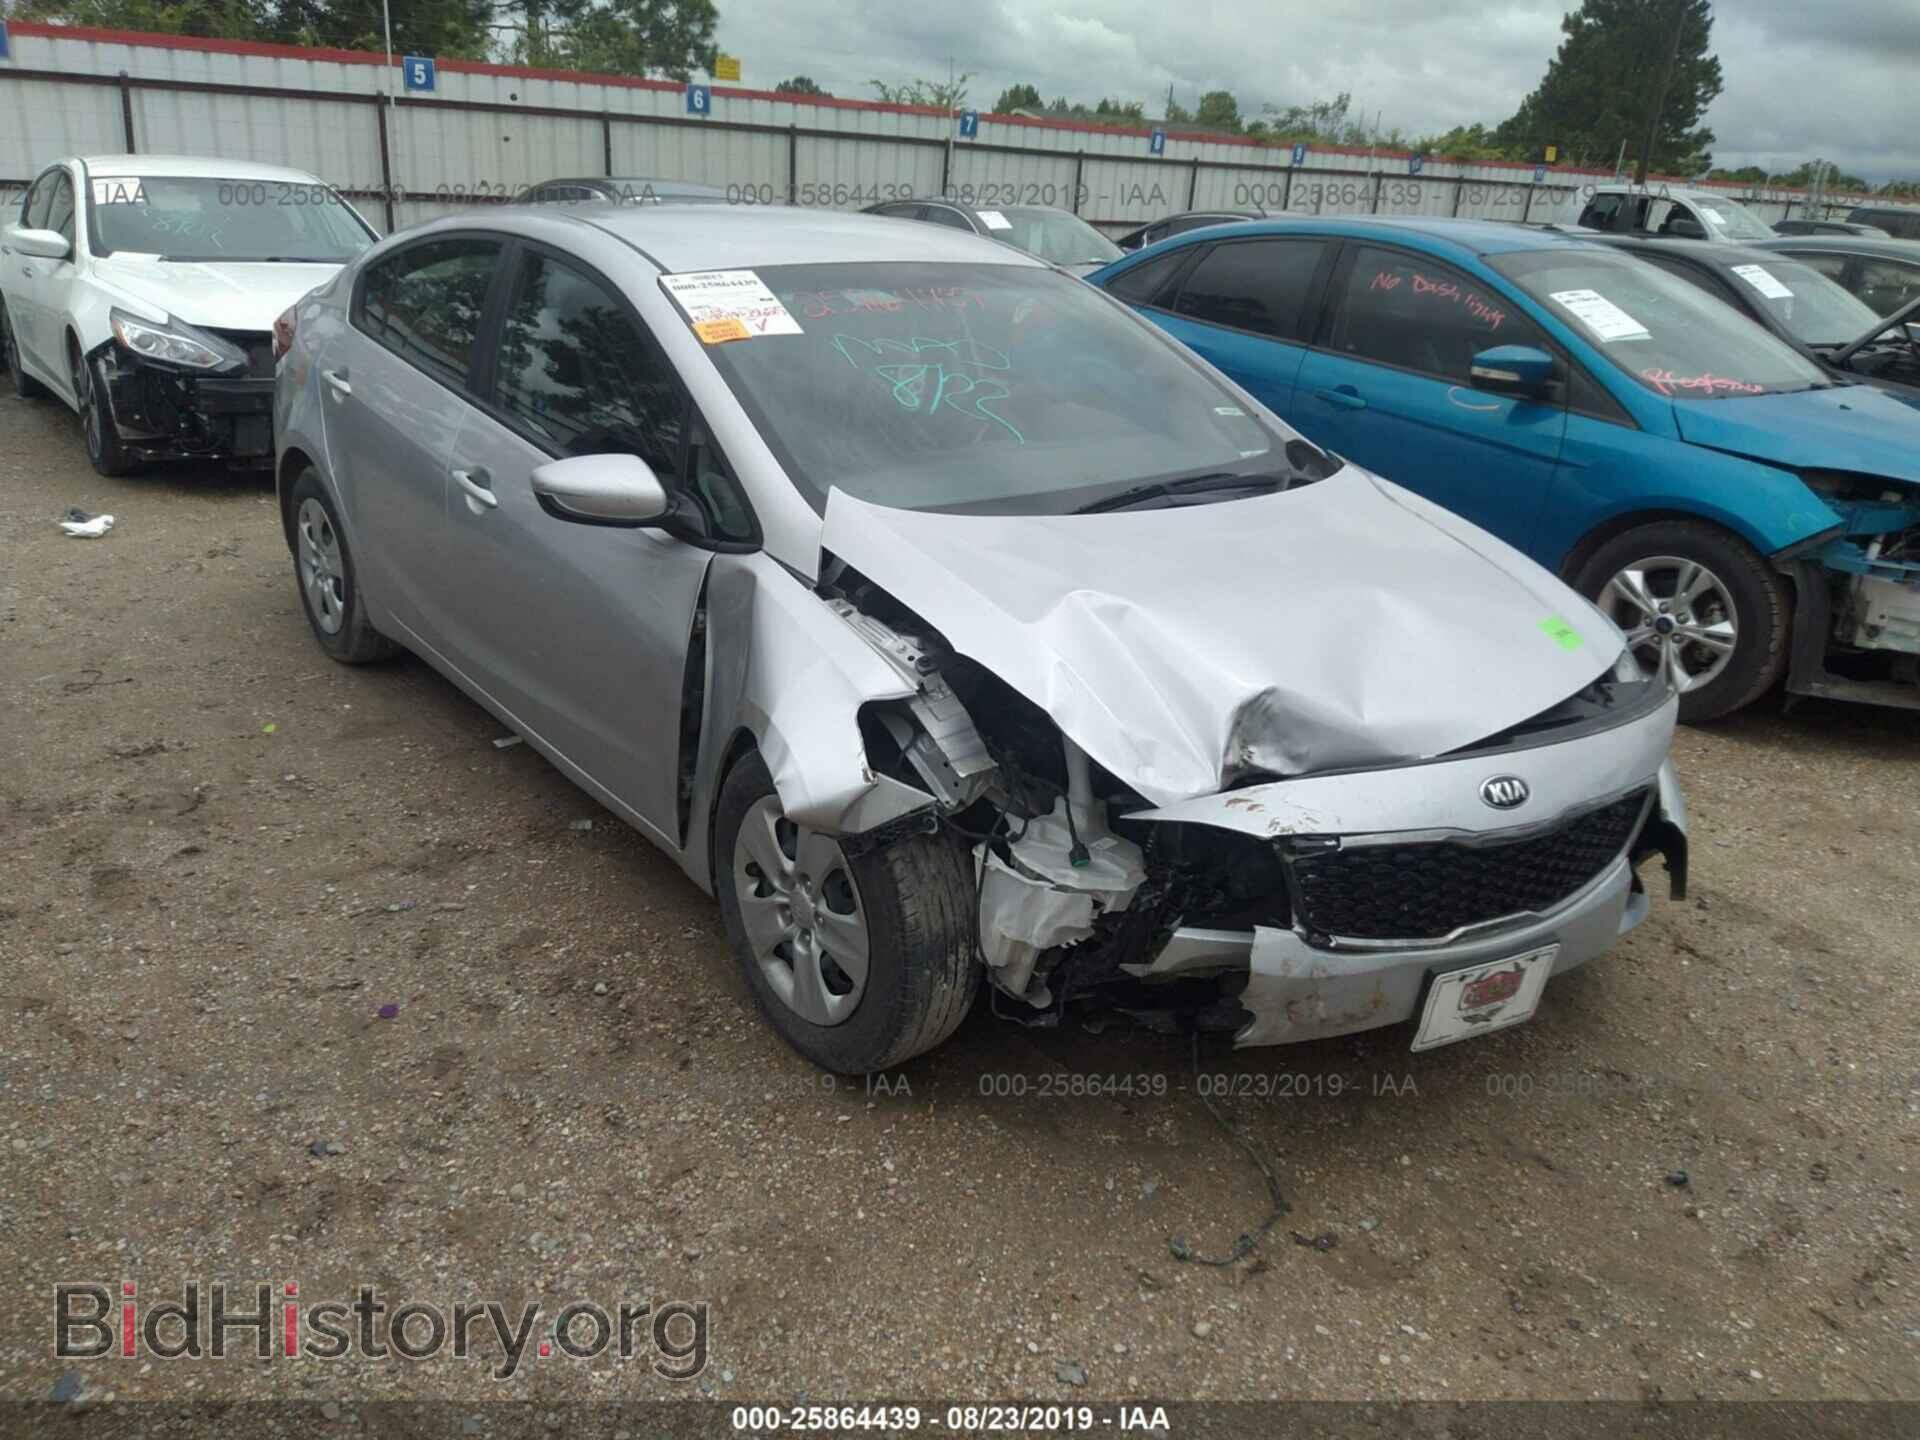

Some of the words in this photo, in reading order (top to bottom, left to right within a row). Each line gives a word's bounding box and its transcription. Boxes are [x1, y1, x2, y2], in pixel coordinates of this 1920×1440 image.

[413, 63, 426, 84] 5
[693, 92, 704, 109] 6
[964, 116, 973, 132] 7
[1371, 272, 1401, 290] No
[1487, 779, 1527, 804] KIA
